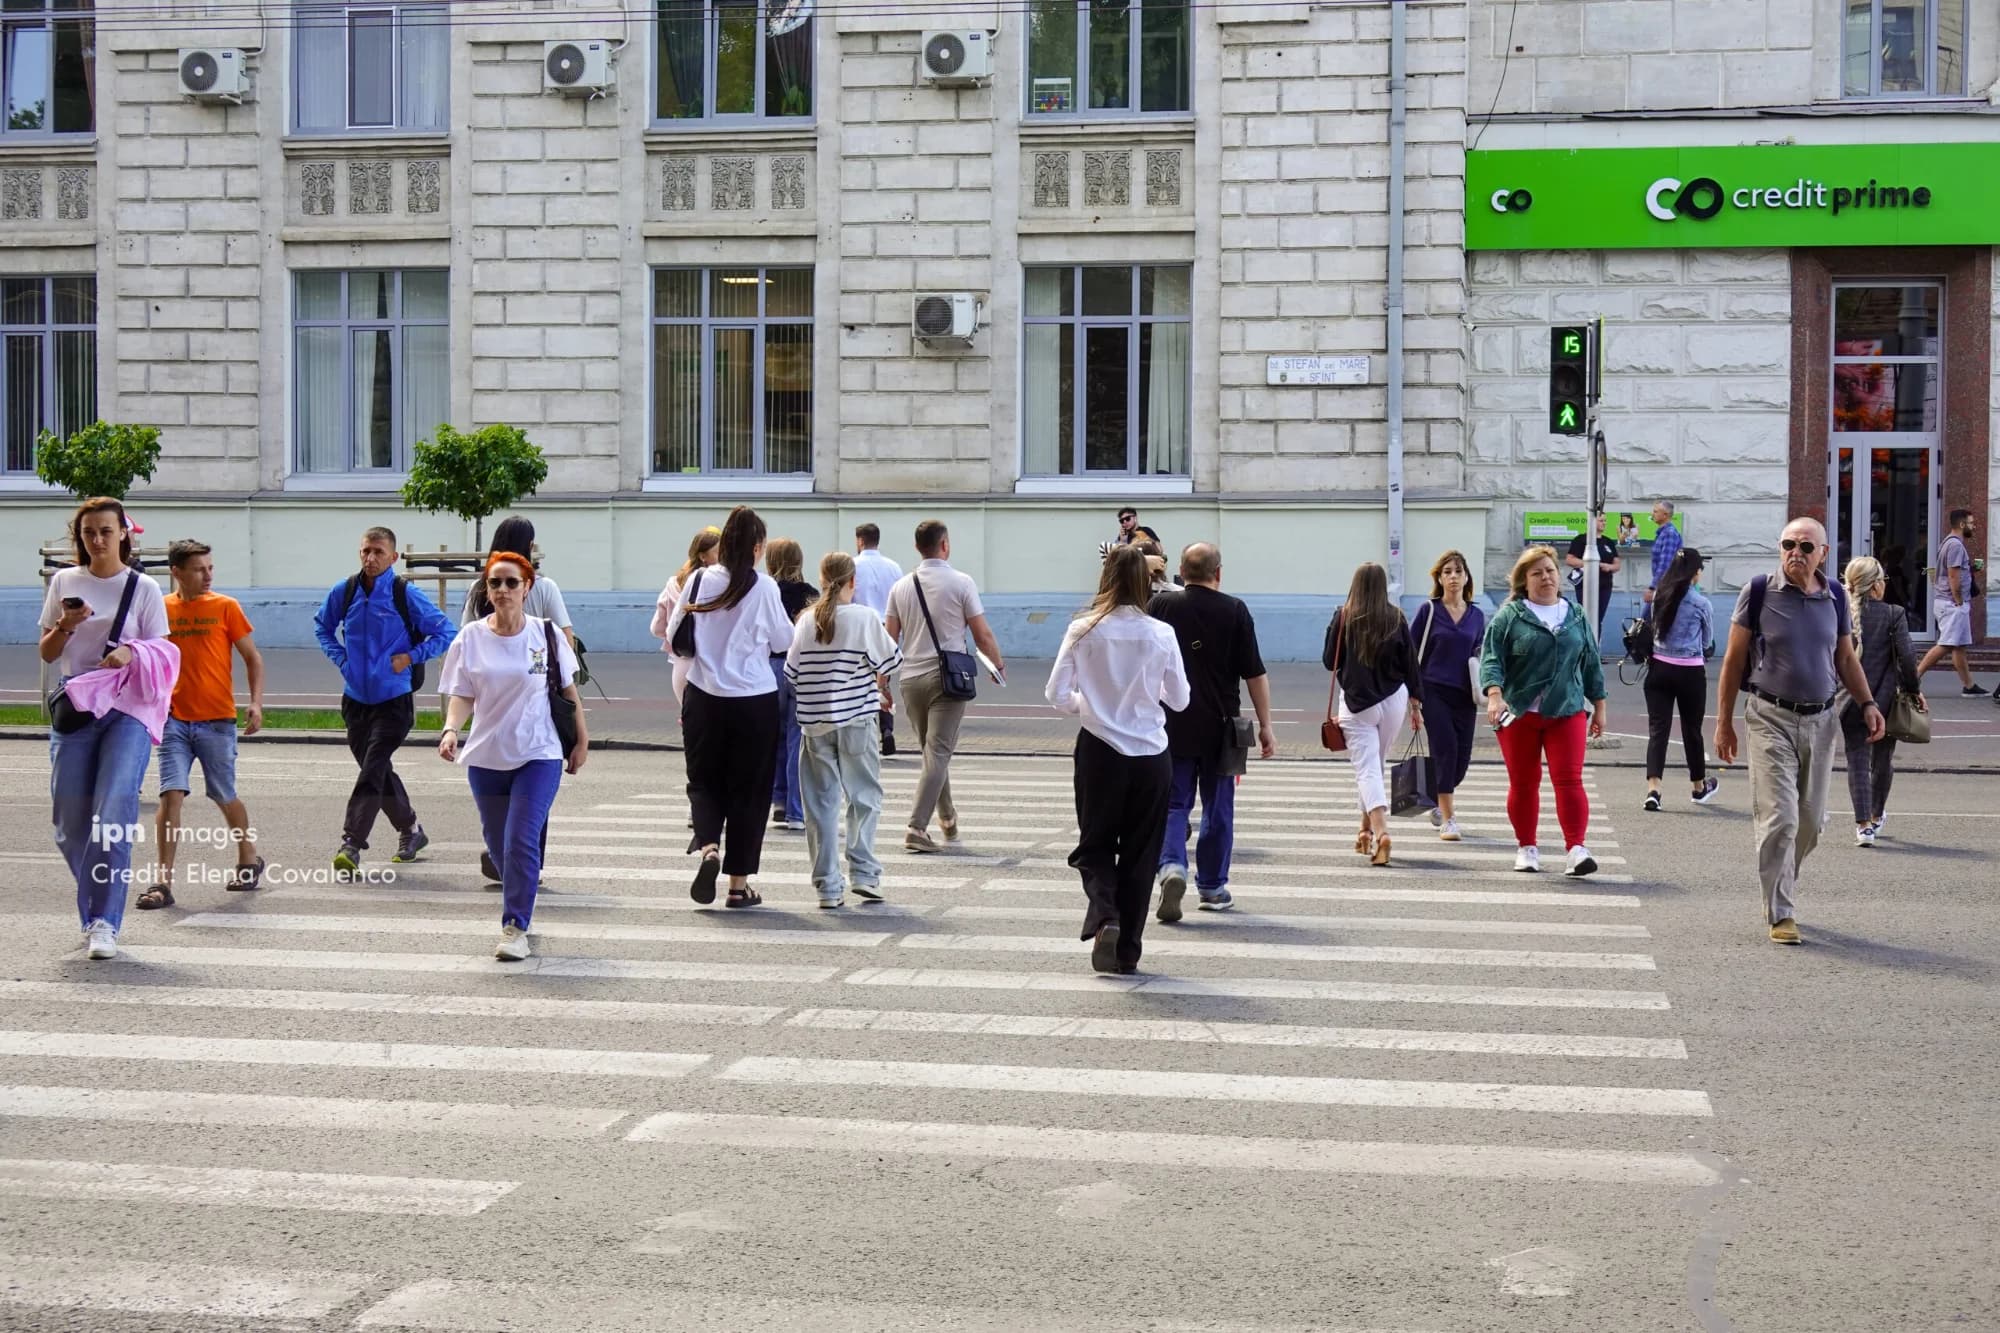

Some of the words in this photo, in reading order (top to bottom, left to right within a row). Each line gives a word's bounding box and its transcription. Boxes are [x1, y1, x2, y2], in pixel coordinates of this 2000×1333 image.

[1732, 178, 1828, 209] credit
[1832, 178, 1932, 216] prime
[1564, 335, 1581, 353] 15
[1339, 358, 1367, 370] MARE
